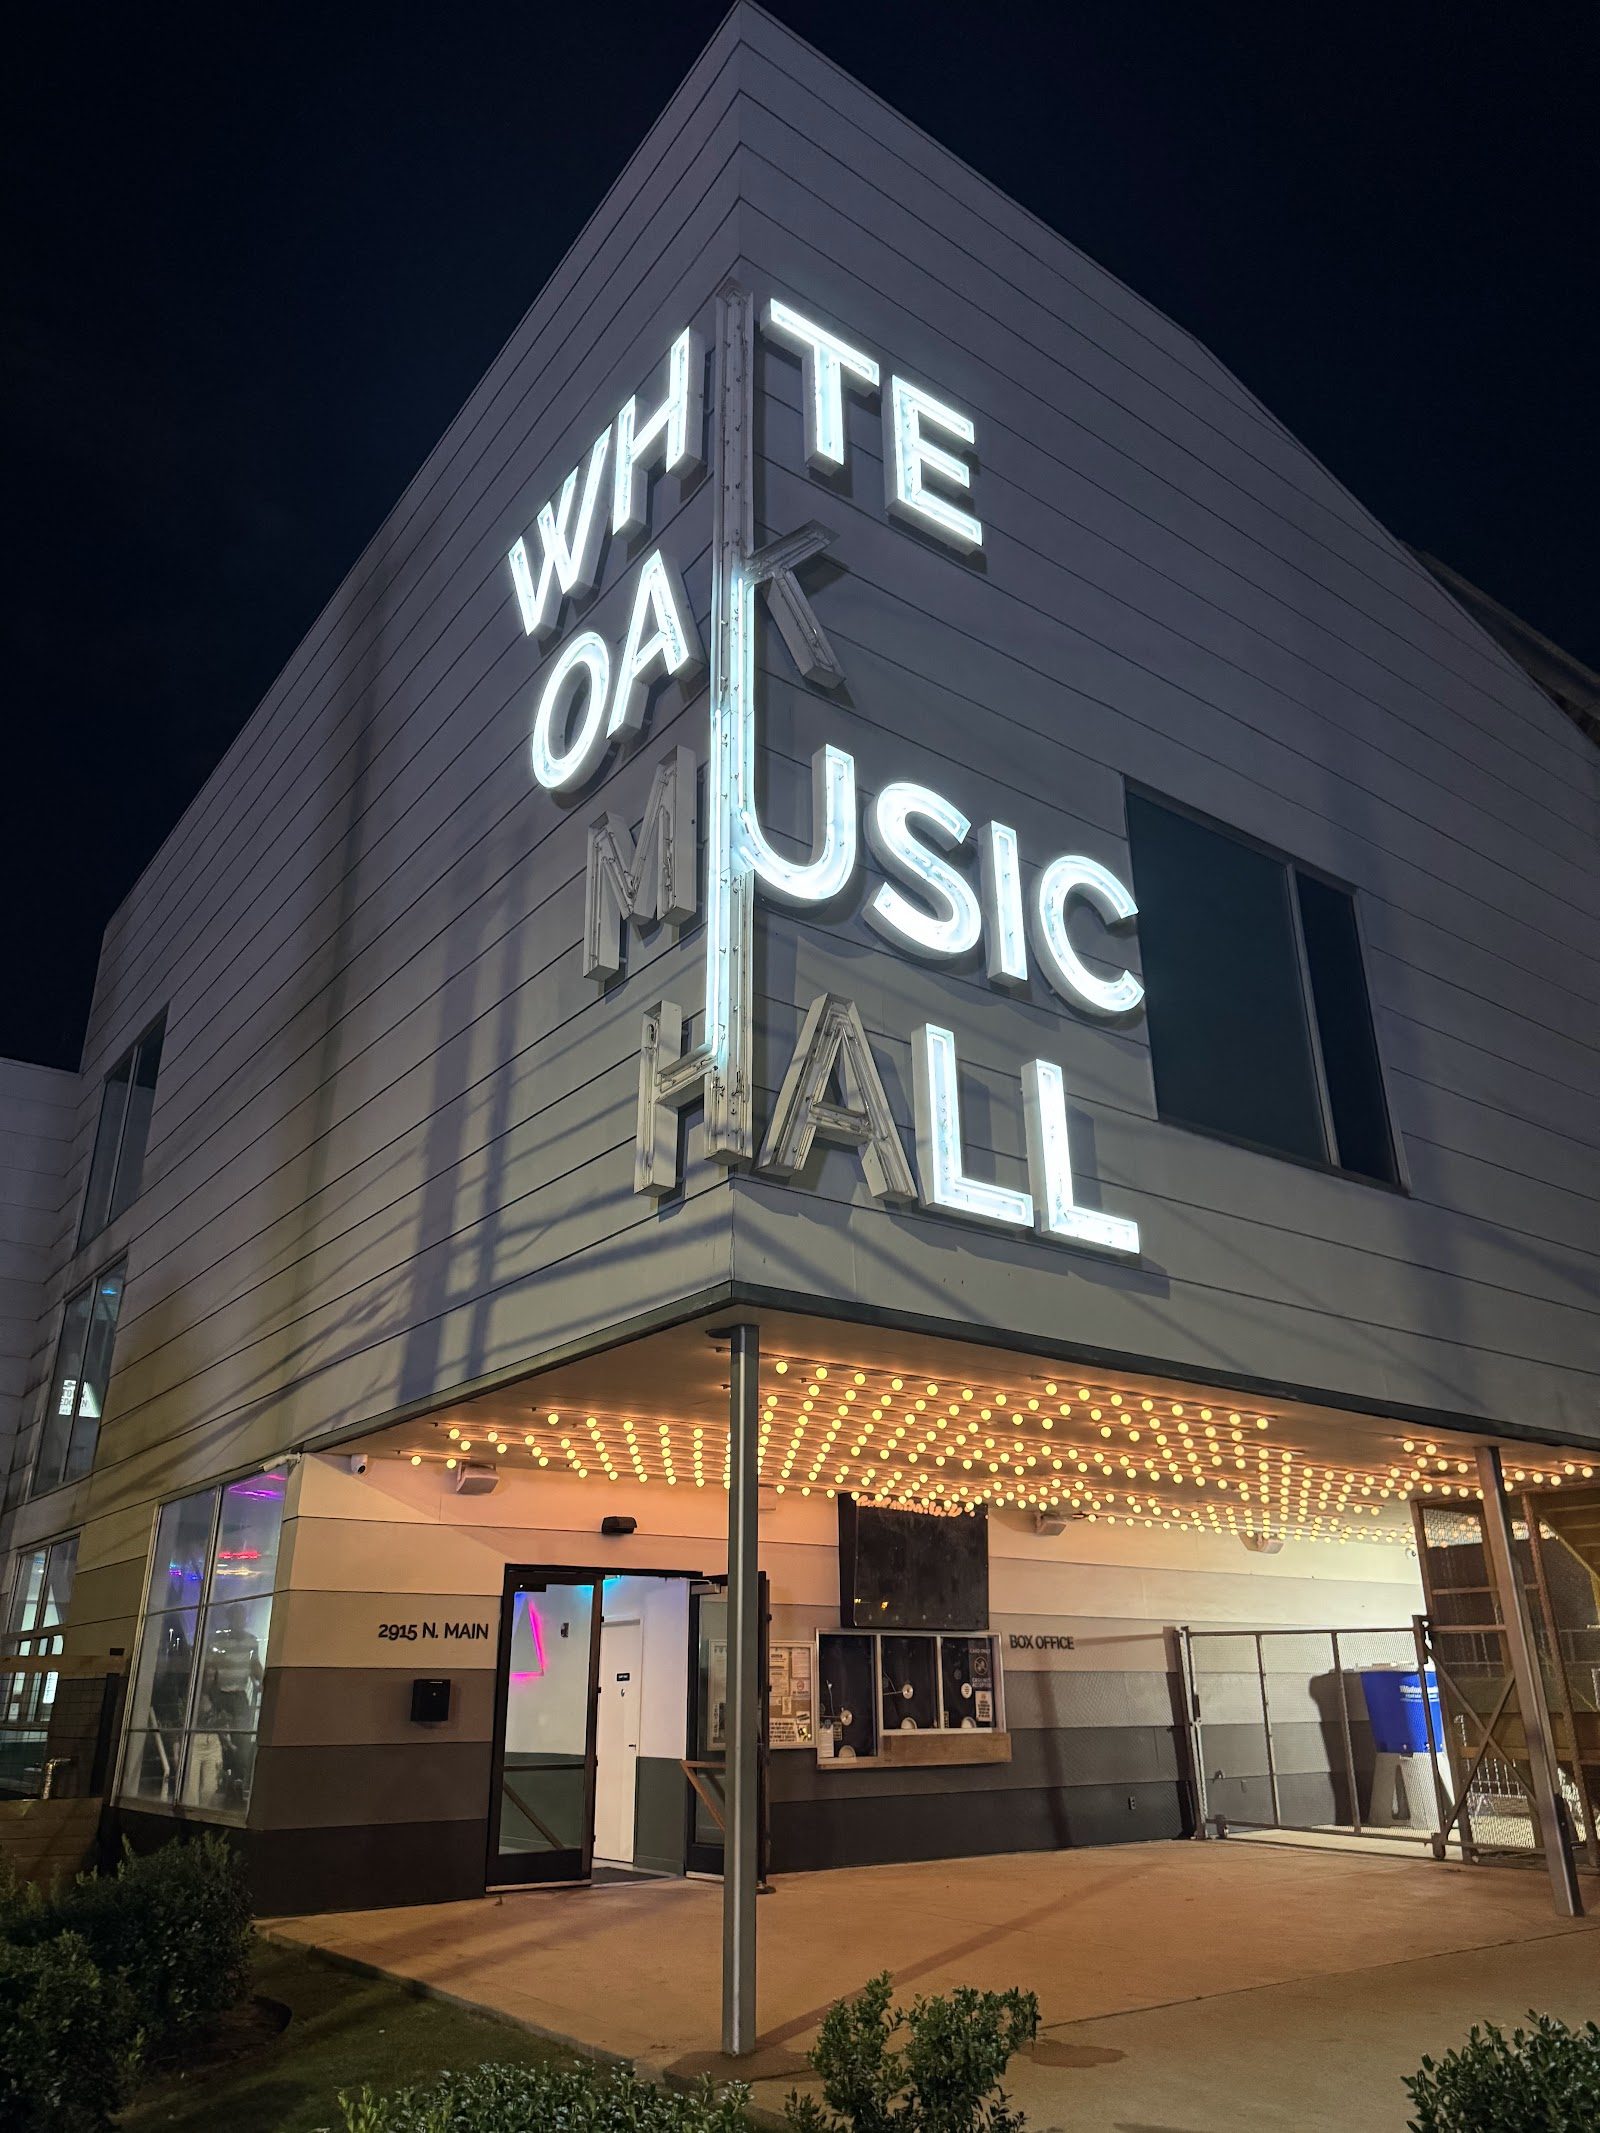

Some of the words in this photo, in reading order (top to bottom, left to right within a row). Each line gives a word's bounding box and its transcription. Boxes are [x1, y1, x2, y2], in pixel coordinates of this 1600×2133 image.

[509, 284, 983, 636] WHITE
[532, 519, 845, 790] OAK
[584, 743, 1145, 1012] MUSIC
[633, 992, 1141, 1254] HALL
[378, 1624, 418, 1640] 2915
[422, 1622, 438, 1638] N.
[444, 1622, 489, 1639] MAIN
[1009, 1634, 1034, 1649] BOX
[1035, 1635, 1075, 1650] OFFICE
